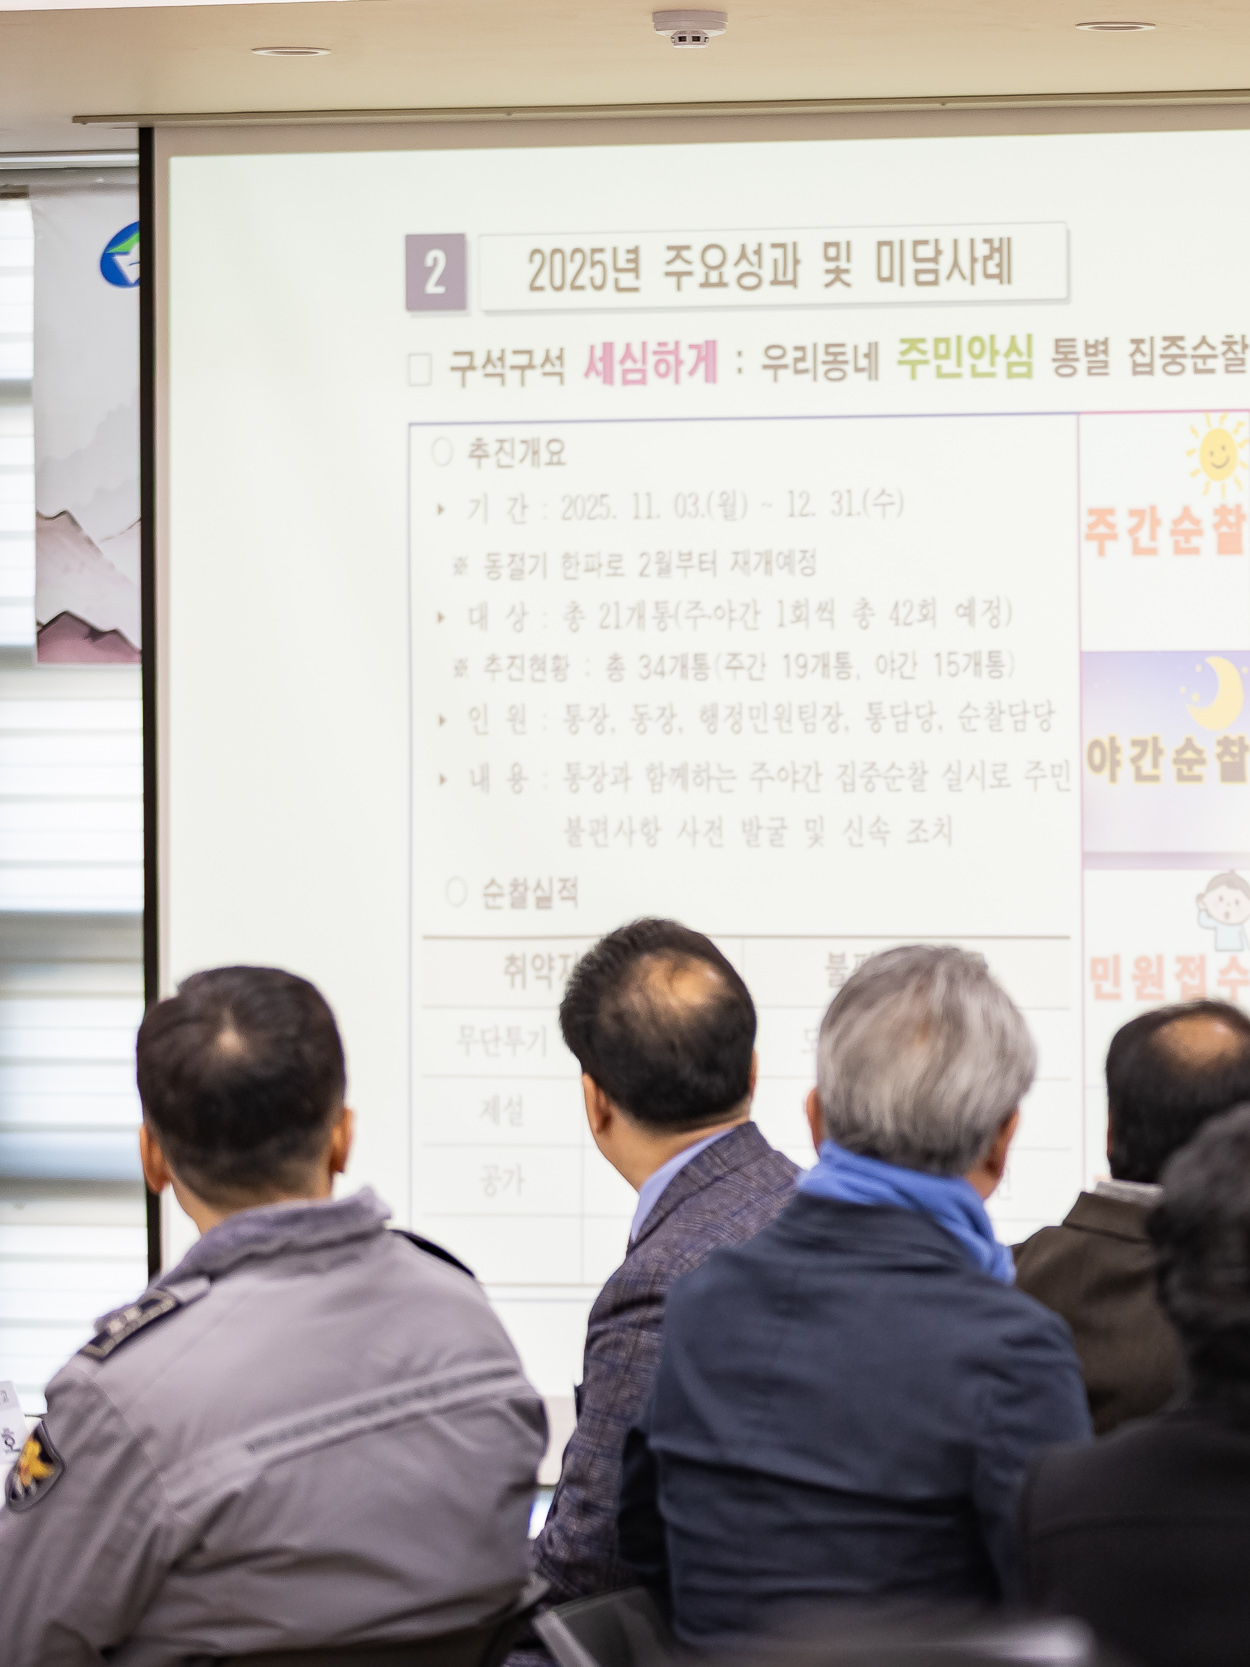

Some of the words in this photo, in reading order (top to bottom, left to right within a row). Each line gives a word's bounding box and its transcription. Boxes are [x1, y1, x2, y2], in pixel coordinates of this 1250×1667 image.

[423, 248, 448, 296] 2
[529, 246, 640, 293] 2025년
[664, 241, 801, 291] 주요성과
[823, 241, 851, 288] 및
[876, 237, 1012, 287] 미담사례
[450, 347, 564, 388] 구석구석
[584, 340, 717, 386] 세심하게
[762, 342, 878, 382] 우리동네
[897, 334, 1032, 380] 주민안심
[1052, 337, 1109, 378] 통별
[1129, 334, 1249, 376] 집중순찰
[468, 437, 566, 469] 추진개요
[561, 493, 616, 521] 2025.
[633, 492, 660, 520] 11.
[674, 489, 748, 522] 03.(월)
[788, 490, 815, 518] 12.
[831, 488, 904, 519] 31.(수)
[1083, 503, 1248, 558] 주간순찰
[484, 552, 547, 581] 동절기
[562, 552, 625, 580] 한파로
[639, 550, 717, 578] 2월부터
[730, 549, 816, 577] 재개예정
[778, 598, 835, 629] 1회씩
[889, 597, 936, 628] 42회
[955, 596, 1012, 629] 예정)
[484, 653, 569, 682] 추진현황
[639, 652, 766, 681] 34개통(주간
[875, 651, 918, 680] 야간
[934, 650, 1013, 679] 15개통)
[563, 703, 615, 735] 통장,
[631, 703, 683, 735] 동장,
[699, 701, 849, 735] 행정민원팀장,
[958, 700, 1056, 733] 순찰담당
[564, 762, 632, 794] 통장과
[645, 761, 737, 794] 함께하는
[837, 760, 928, 793] 집중순찰
[942, 760, 1011, 792] 실시로
[1024, 759, 1071, 792] 주민
[563, 815, 662, 848] 불편사항
[678, 816, 724, 848] 사전
[741, 815, 788, 848] 발굴
[805, 815, 824, 848] 및
[843, 815, 890, 848] 신속
[906, 815, 952, 846] 조치
[483, 877, 577, 910] 순찰실적
[1089, 953, 1250, 1001] 민원접수
[457, 1024, 547, 1058] 무단투기
